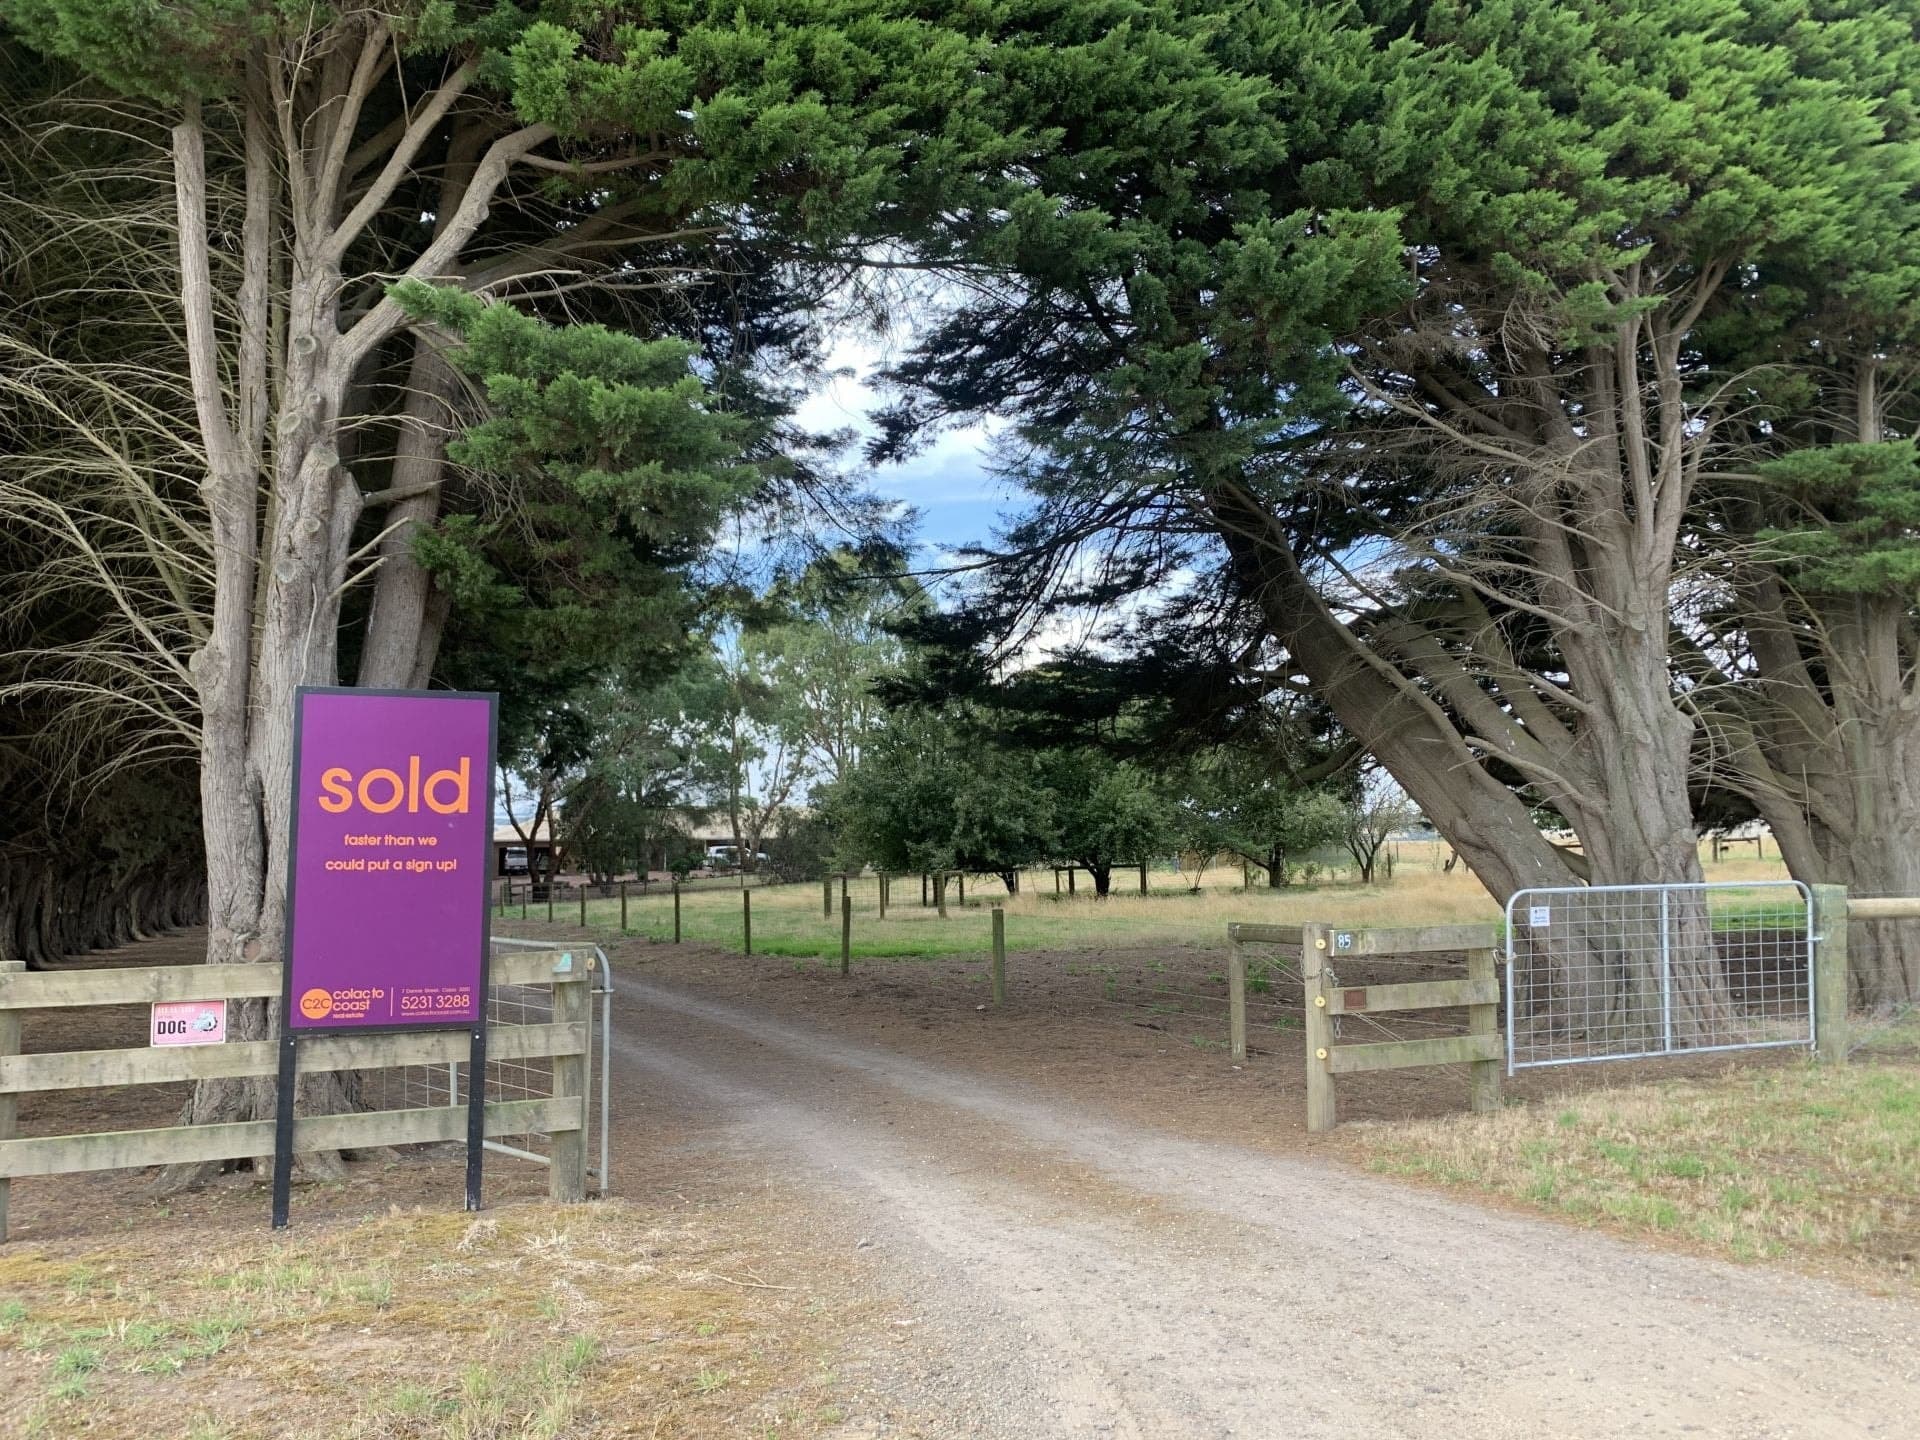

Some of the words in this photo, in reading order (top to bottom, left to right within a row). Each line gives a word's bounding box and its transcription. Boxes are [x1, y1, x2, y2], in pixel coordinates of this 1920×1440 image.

[319, 755, 470, 814] sold
[344, 833, 381, 846] faster
[384, 834, 415, 846] than
[418, 836, 437, 846] we
[325, 859, 365, 871] could
[367, 859, 390, 873] put
[393, 861, 403, 870] a
[405, 859, 433, 873] sign
[436, 859, 457, 872] up!
[1338, 935, 1351, 949] 85
[333, 988, 371, 999] colac
[372, 987, 385, 998] to
[302, 999, 331, 1009] C2C
[333, 1000, 370, 1011] coast
[401, 995, 432, 1010] 5231
[435, 994, 470, 1008] 3288
[158, 1021, 187, 1034] DOG
